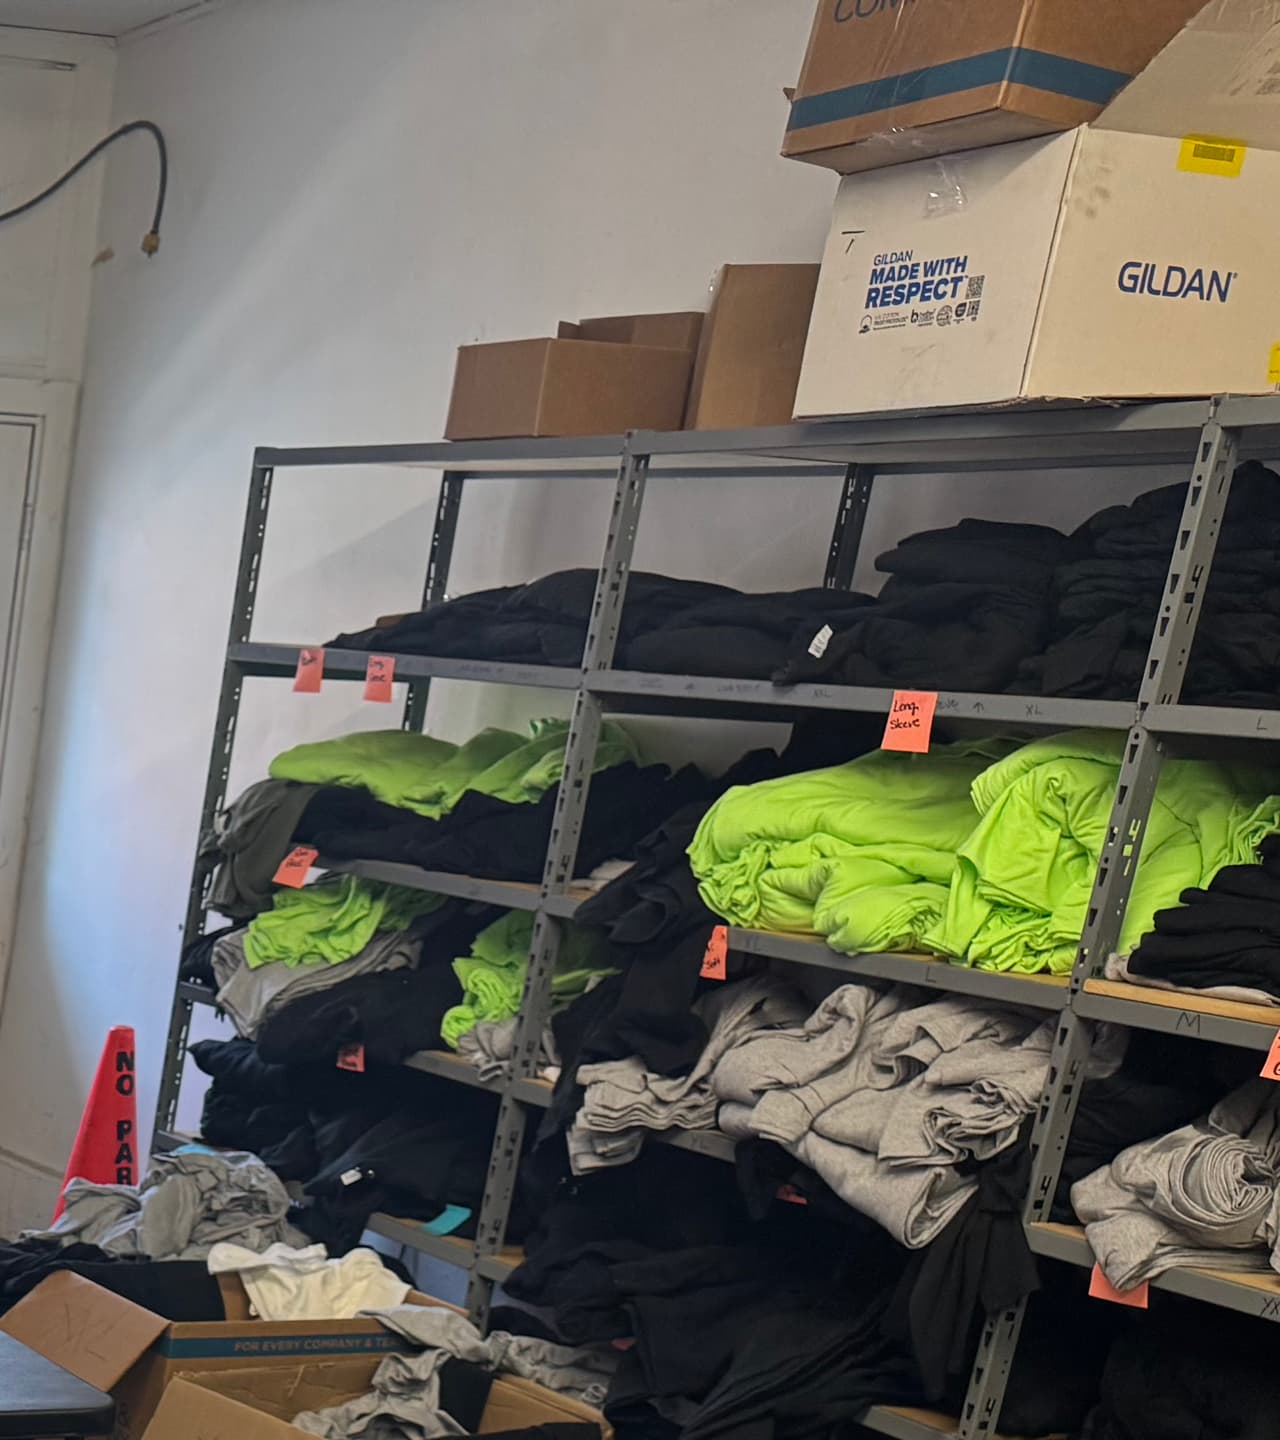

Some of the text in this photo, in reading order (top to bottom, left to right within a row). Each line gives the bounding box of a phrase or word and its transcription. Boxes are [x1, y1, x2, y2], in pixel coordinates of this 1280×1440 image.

[869, 256, 968, 285] MADE WITH
[873, 250, 913, 267] GILDAN
[865, 276, 965, 309] RESPECT
[1117, 260, 1236, 303] GILDAN
[1176, 1011, 1200, 1033] M
[115, 1052, 135, 1096] NO
